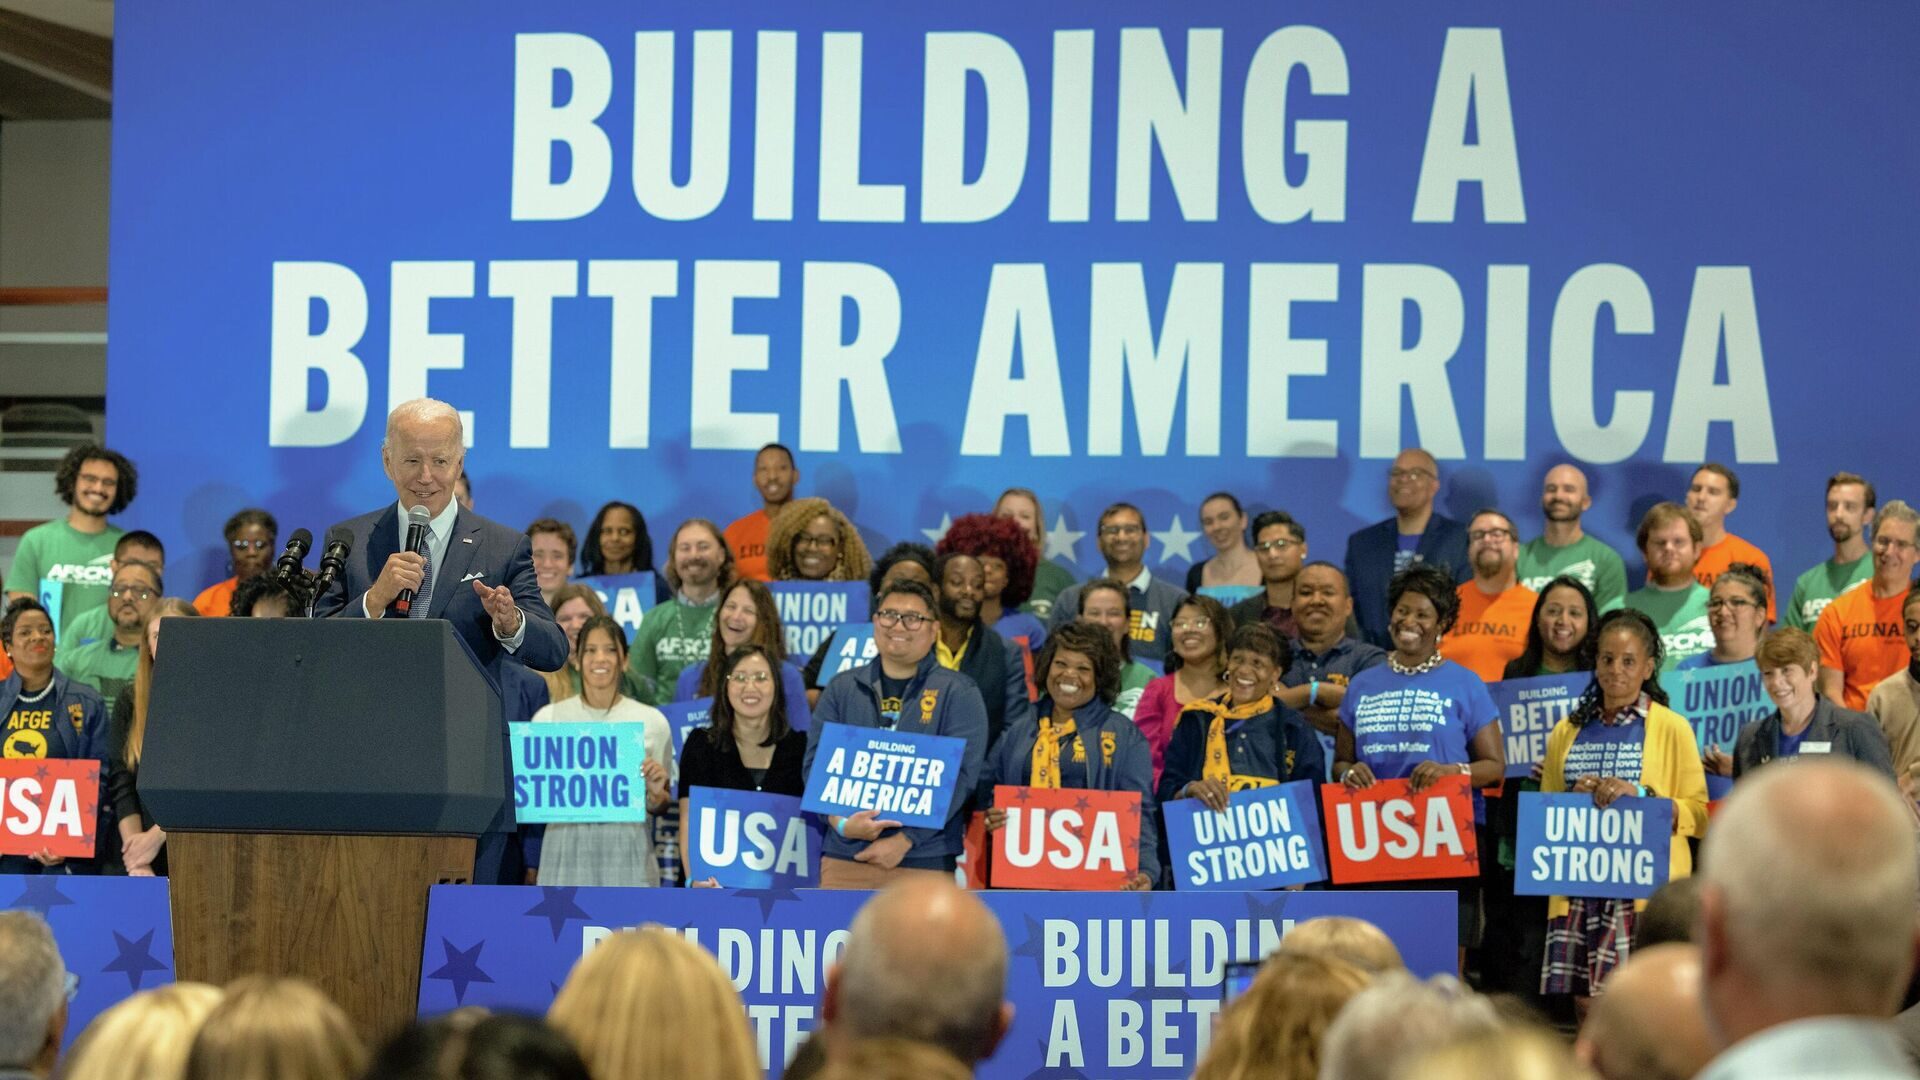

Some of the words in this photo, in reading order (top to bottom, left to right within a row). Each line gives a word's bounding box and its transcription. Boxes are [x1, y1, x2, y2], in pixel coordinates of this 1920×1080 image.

[511, 25, 1349, 224] BUILDING
[1412, 27, 1527, 223] A
[268, 259, 903, 454] BETTER
[960, 262, 1779, 465] AMERICA
[1401, 705, 1411, 714] to
[1402, 697, 1413, 706] to
[1404, 689, 1415, 697] to
[1416, 689, 1431, 697] be
[1518, 686, 1568, 700] BUILDING
[1684, 672, 1763, 712] UNION
[8, 711, 52, 730] AFGE
[1398, 722, 1409, 732] to
[1410, 722, 1433, 732] vote
[1399, 713, 1409, 721] to
[523, 736, 617, 770] UNION
[867, 740, 916, 754] BUILDING
[1602, 760, 1613, 769] to
[1604, 752, 1615, 760] to
[1605, 742, 1616, 751] to
[826, 747, 845, 775] A
[851, 750, 945, 787] BETTER
[0, 777, 84, 837] SA
[514, 774, 629, 808] STRONG
[820, 776, 933, 816] AMERICA
[1004, 806, 1126, 872] USA
[1192, 798, 1292, 846] UNION
[1335, 796, 1466, 863] USA
[1545, 806, 1644, 845] UNION
[699, 806, 809, 878] USA
[1187, 834, 1310, 887] STRONG
[1531, 845, 1654, 886] STRONG
[1045, 999, 1085, 1067] A
